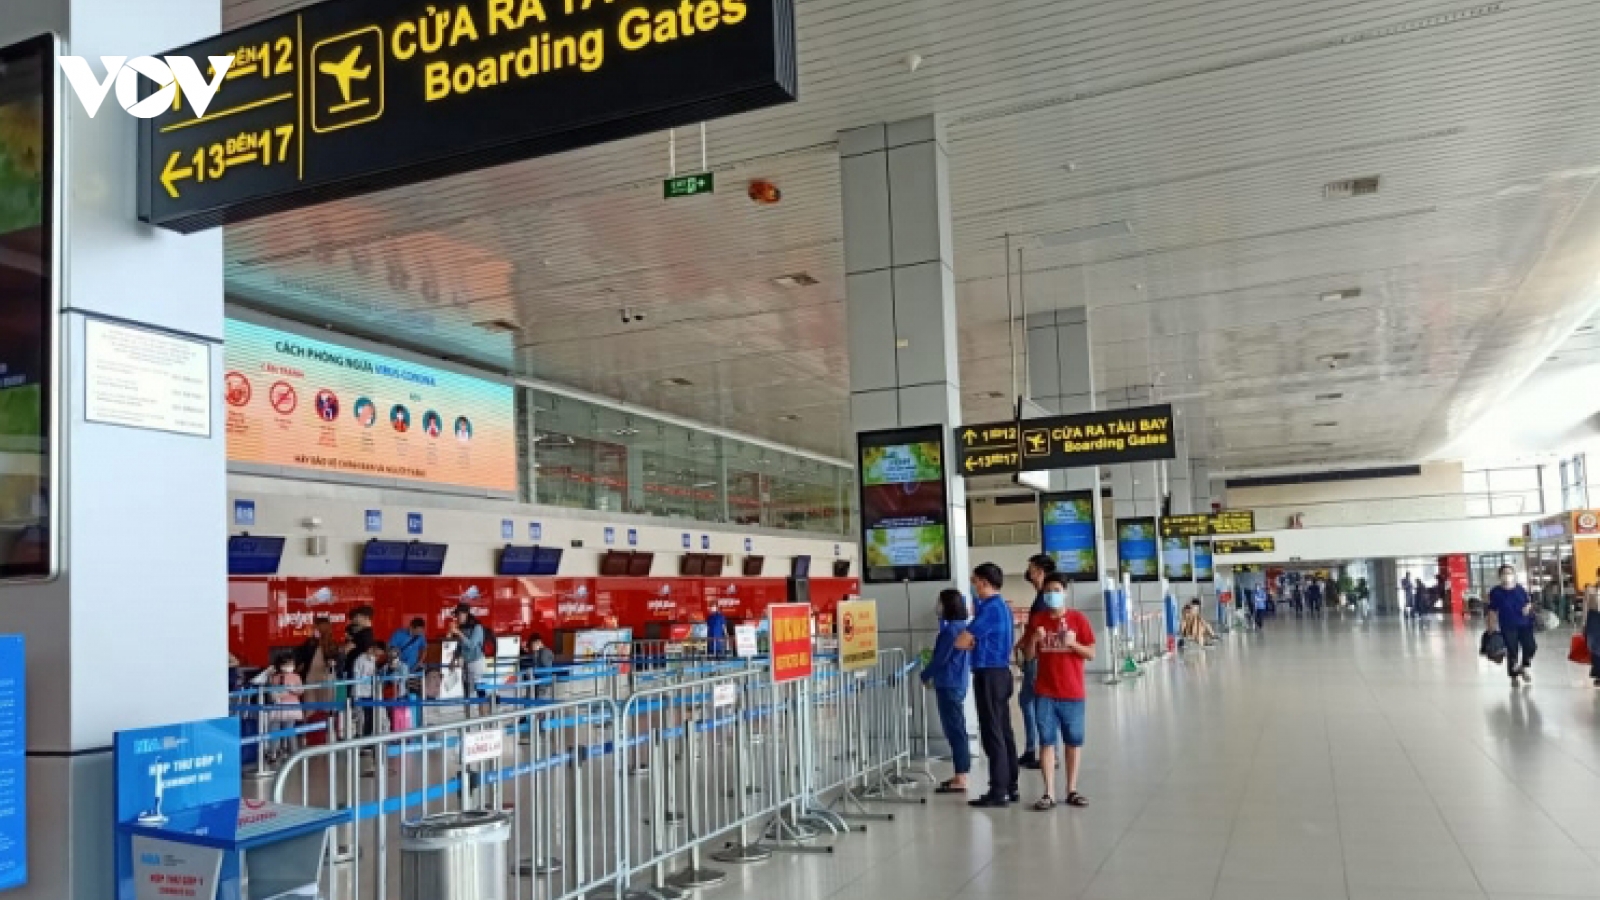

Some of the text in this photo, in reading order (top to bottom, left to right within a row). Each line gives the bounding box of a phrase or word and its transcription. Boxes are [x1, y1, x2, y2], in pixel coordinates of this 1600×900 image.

[392, 0, 547, 60] CỬA RA
[424, 0, 748, 102] Boarding Gates
[259, 36, 294, 79] 12
[192, 143, 226, 183] 13
[258, 124, 294, 166] 17
[1064, 434, 1168, 453] Boarding Gates
[1086, 424, 1105, 438] RA
[1140, 416, 1169, 431] BAY
